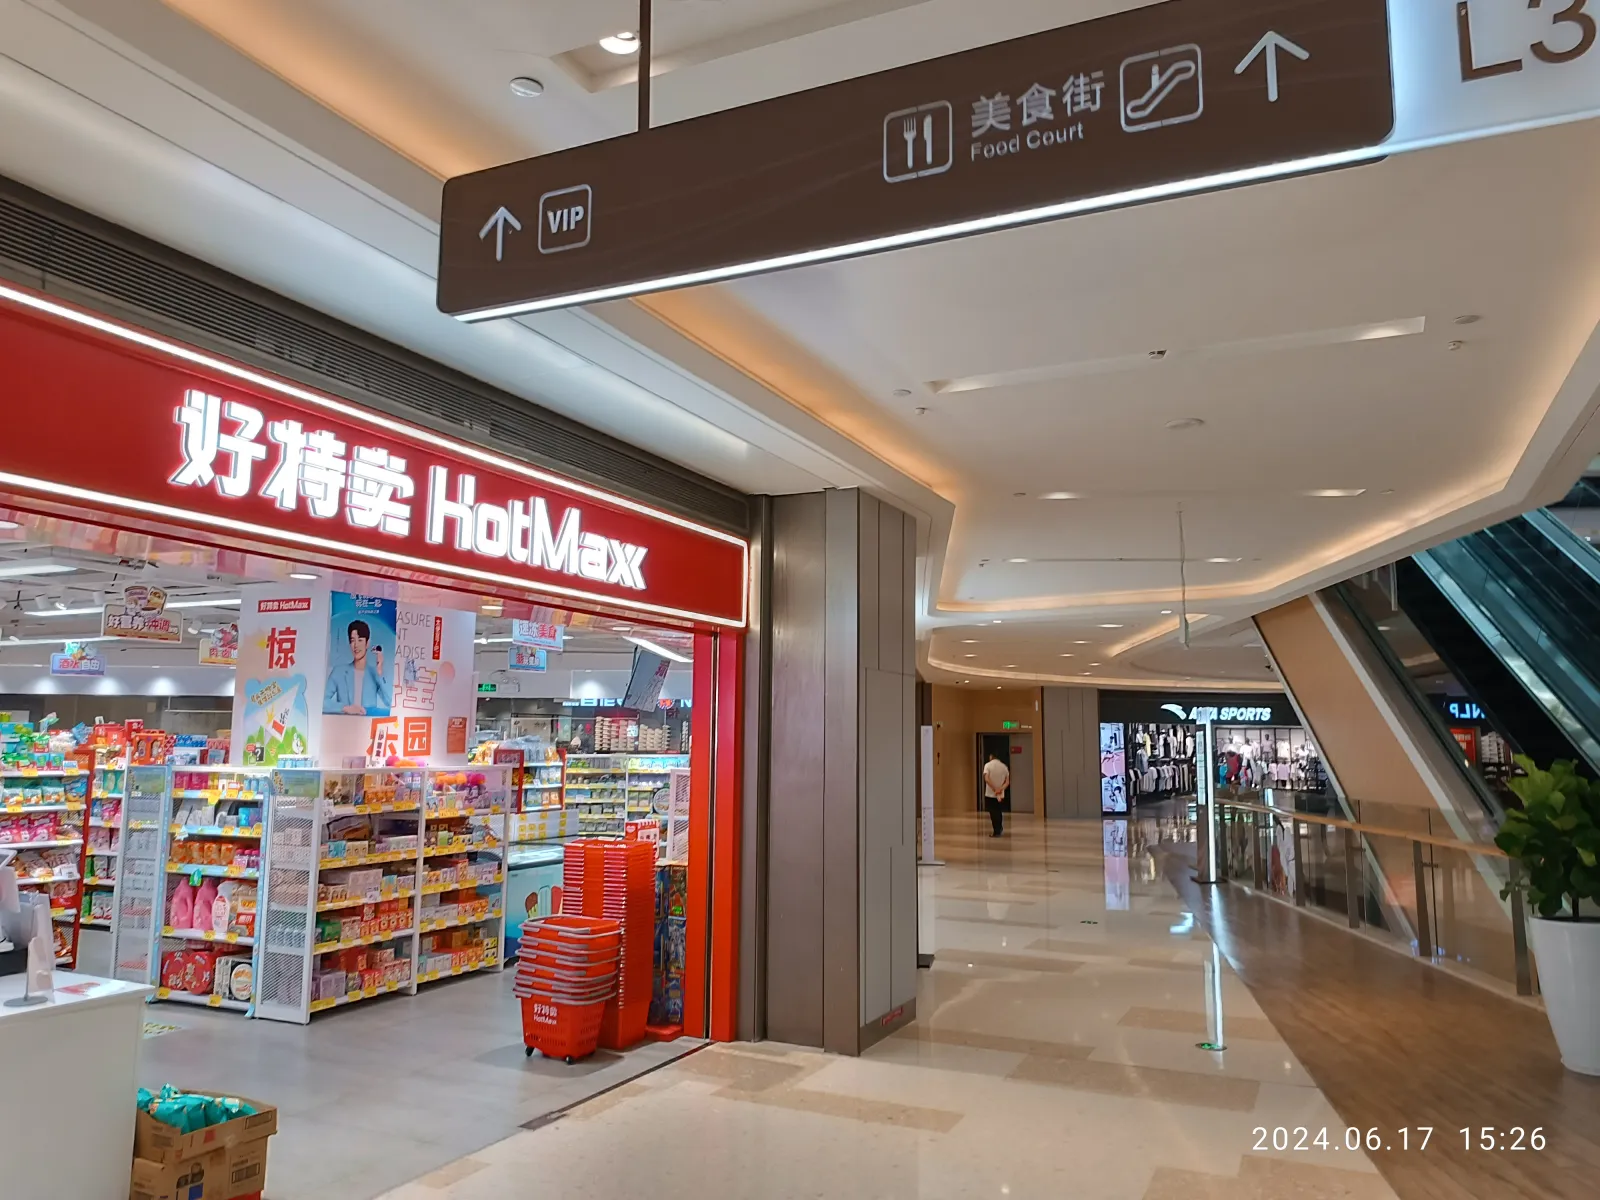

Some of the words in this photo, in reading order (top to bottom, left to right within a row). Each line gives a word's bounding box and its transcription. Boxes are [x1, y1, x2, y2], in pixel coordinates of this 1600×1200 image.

[1457, 0, 1597, 83] L3
[971, 70, 1105, 138] 美食街
[971, 133, 1020, 161] Food
[1026, 121, 1084, 149] Court
[547, 205, 585, 234] VIP
[166, 388, 414, 537] 好特卖
[59, 658, 100, 670] 酒水自由
[266, 626, 297, 669] 惊
[1219, 706, 1272, 721] SPORTS
[366, 715, 433, 757] 乐园
[533, 1003, 558, 1017] 好特卖
